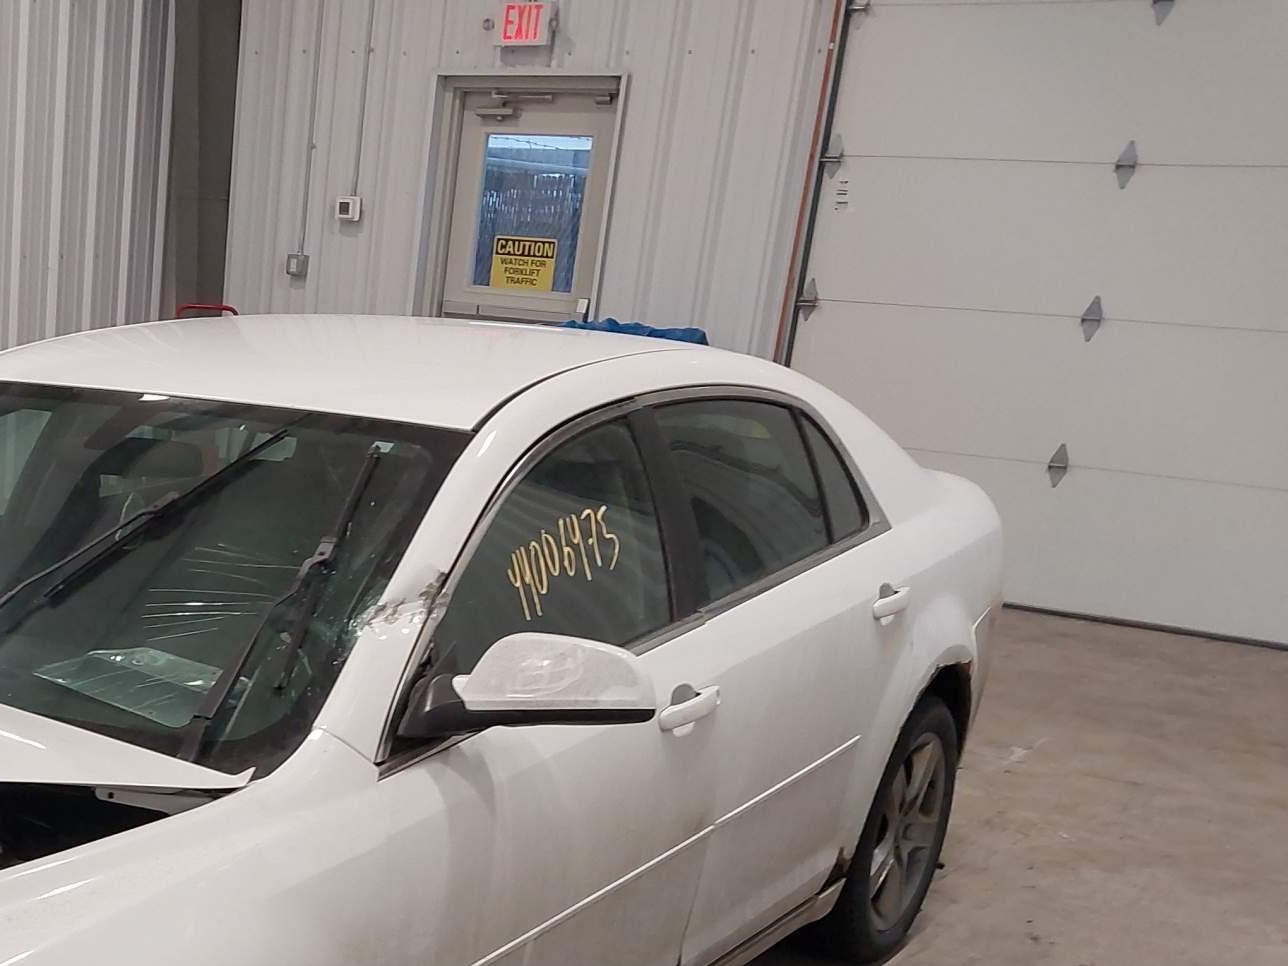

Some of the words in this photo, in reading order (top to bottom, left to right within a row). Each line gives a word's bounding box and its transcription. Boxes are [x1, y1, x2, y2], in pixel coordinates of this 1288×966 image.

[503, 5, 543, 40] EXIT
[497, 239, 553, 256] CAUTION
[500, 257, 529, 267] WATCH
[530, 259, 547, 268] FOR
[504, 267, 540, 276] FORKLIFT
[505, 276, 537, 286] TRAFFIC
[507, 504, 620, 621] 44006475
